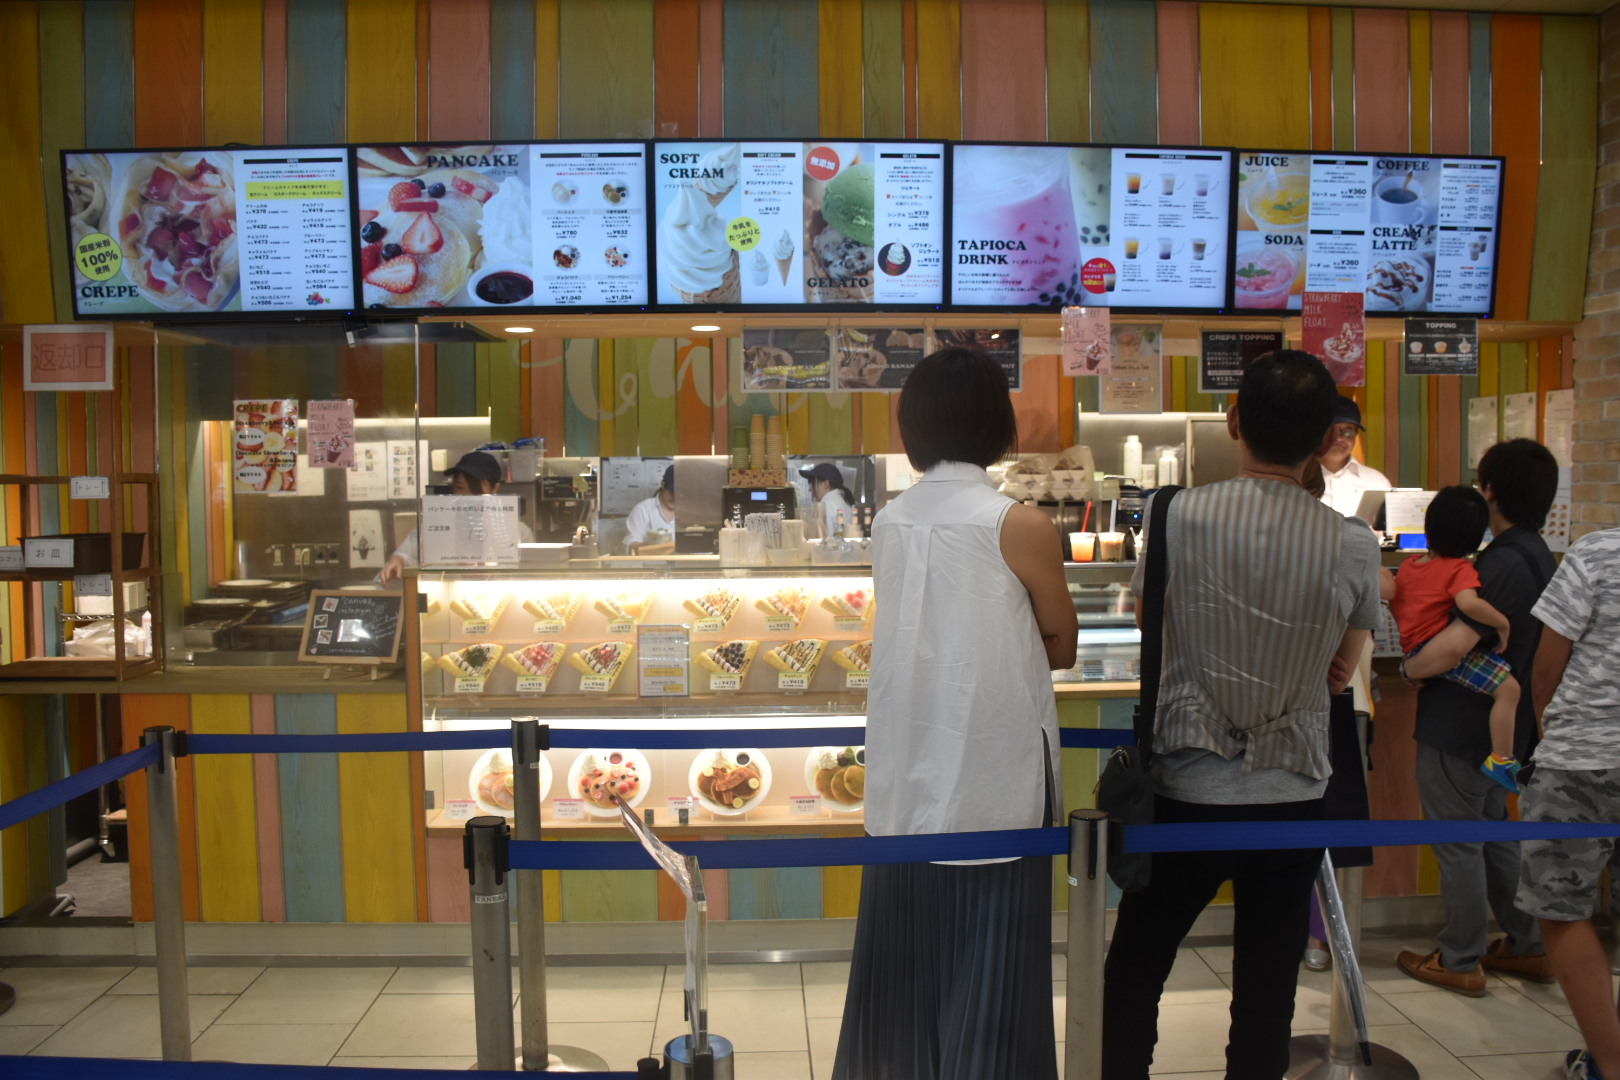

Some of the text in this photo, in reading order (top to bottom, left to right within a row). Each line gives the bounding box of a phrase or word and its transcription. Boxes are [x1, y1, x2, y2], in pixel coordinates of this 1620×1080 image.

[426, 154, 519, 168] PANCAKE
[660, 154, 700, 164] SOFT
[810, 157, 836, 170] 無添加
[1245, 156, 1289, 167] JUICE
[1376, 160, 1430, 171] COFFEE
[669, 168, 724, 178] CREAM
[729, 229, 760, 241] たっぷりと
[1373, 227, 1422, 237] CREAM
[958, 240, 1027, 250] TAPIOCA
[1265, 235, 1304, 245] SODA
[1372, 240, 1416, 250] LATTE
[79, 239, 110, 253] 国産米粉
[82, 250, 118, 267] 100%
[958, 254, 1009, 265] DRINK
[95, 264, 110, 274] 使用
[807, 277, 869, 288] GELATO
[81, 285, 139, 298] CREPE
[1304, 294, 1342, 303] STRAWBERRY
[1304, 304, 1322, 314] MILK
[1304, 317, 1327, 327] FLOAT
[32, 344, 104, 371] 返却口
[237, 404, 268, 413] CREPE
